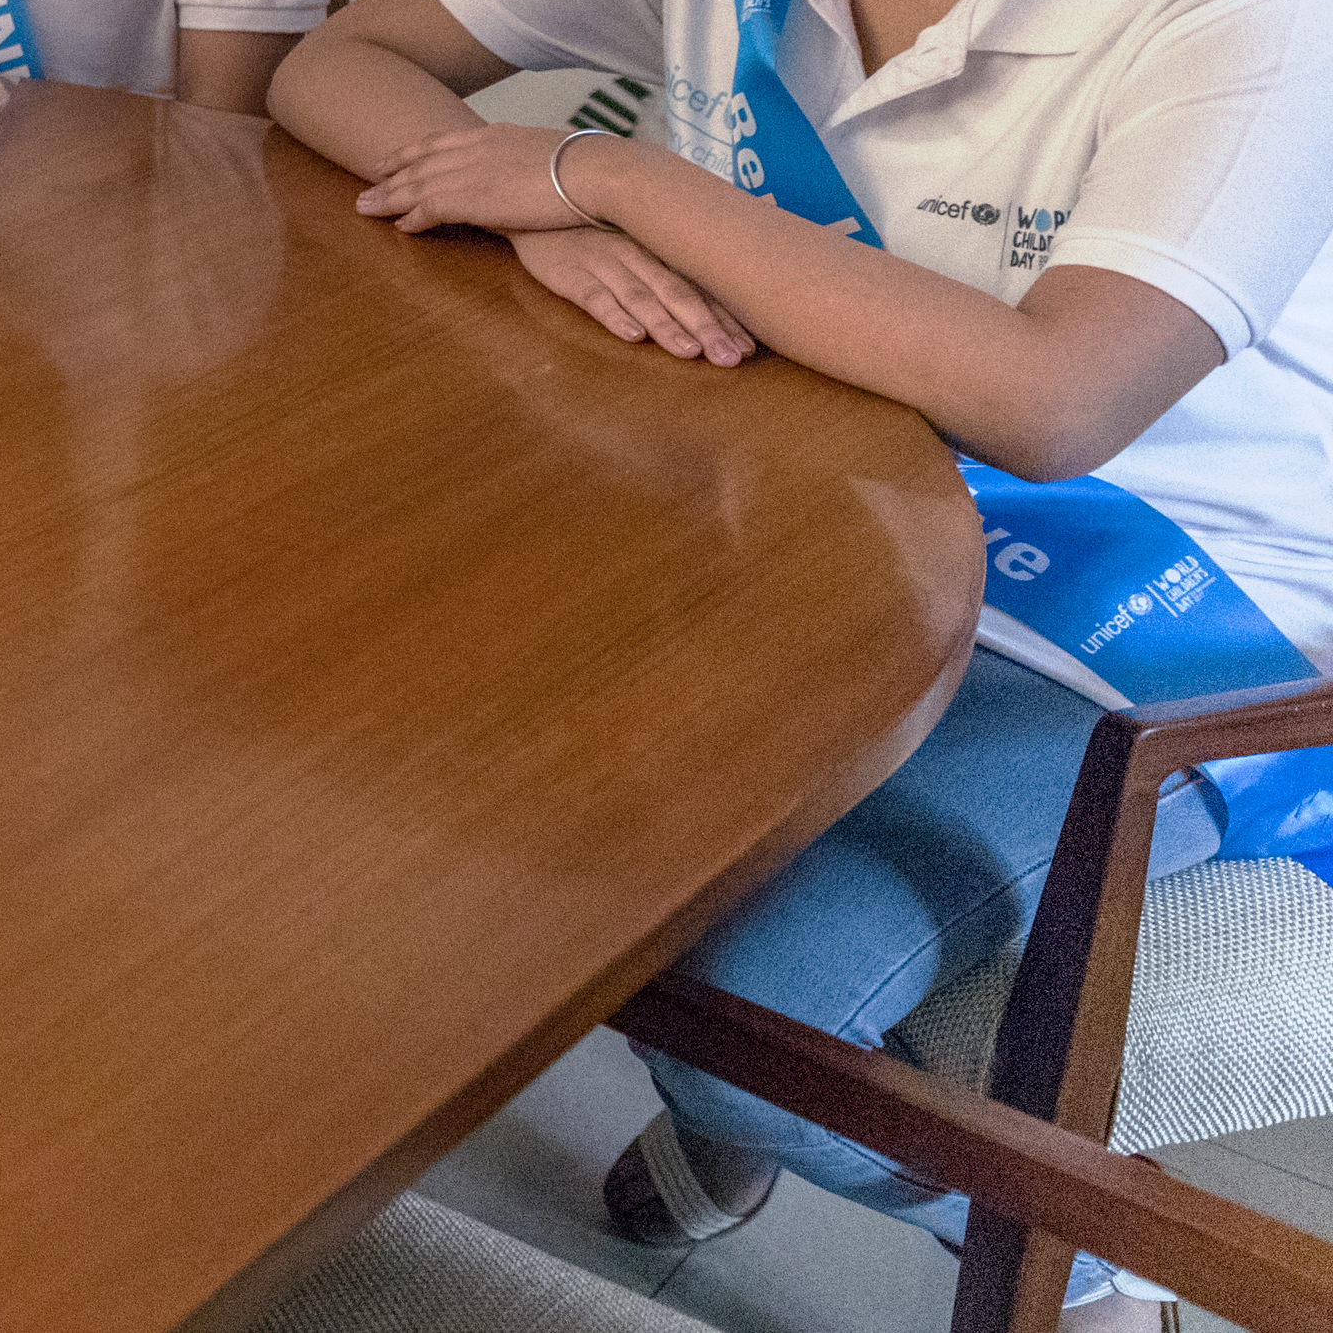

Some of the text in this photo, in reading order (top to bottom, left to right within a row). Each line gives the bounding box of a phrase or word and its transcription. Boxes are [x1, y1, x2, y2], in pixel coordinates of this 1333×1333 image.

[916, 195, 972, 220] unicef
[1010, 249, 1035, 270] DAY
[1080, 604, 1135, 654] unicef
